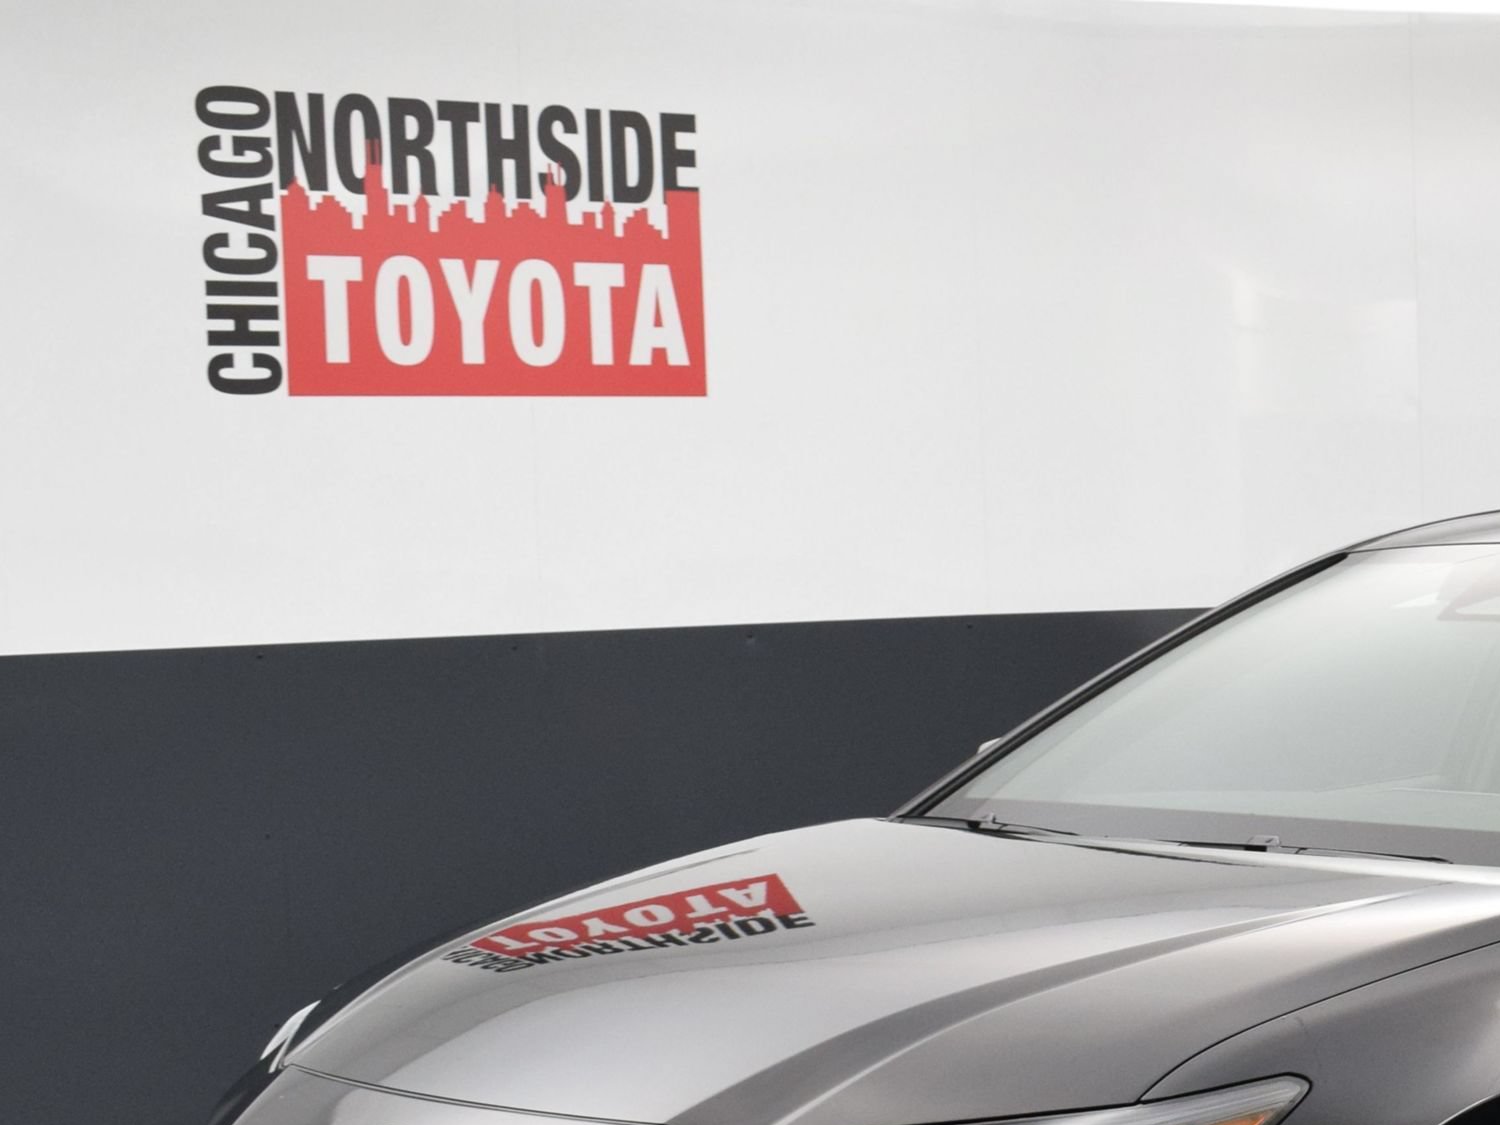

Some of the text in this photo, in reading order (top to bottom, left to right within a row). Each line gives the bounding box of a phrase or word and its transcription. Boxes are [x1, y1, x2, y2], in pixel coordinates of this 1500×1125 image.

[274, 91, 699, 204] NORTHSIDE
[195, 85, 283, 396] CHICAGO
[306, 254, 691, 367] TOYOTA
